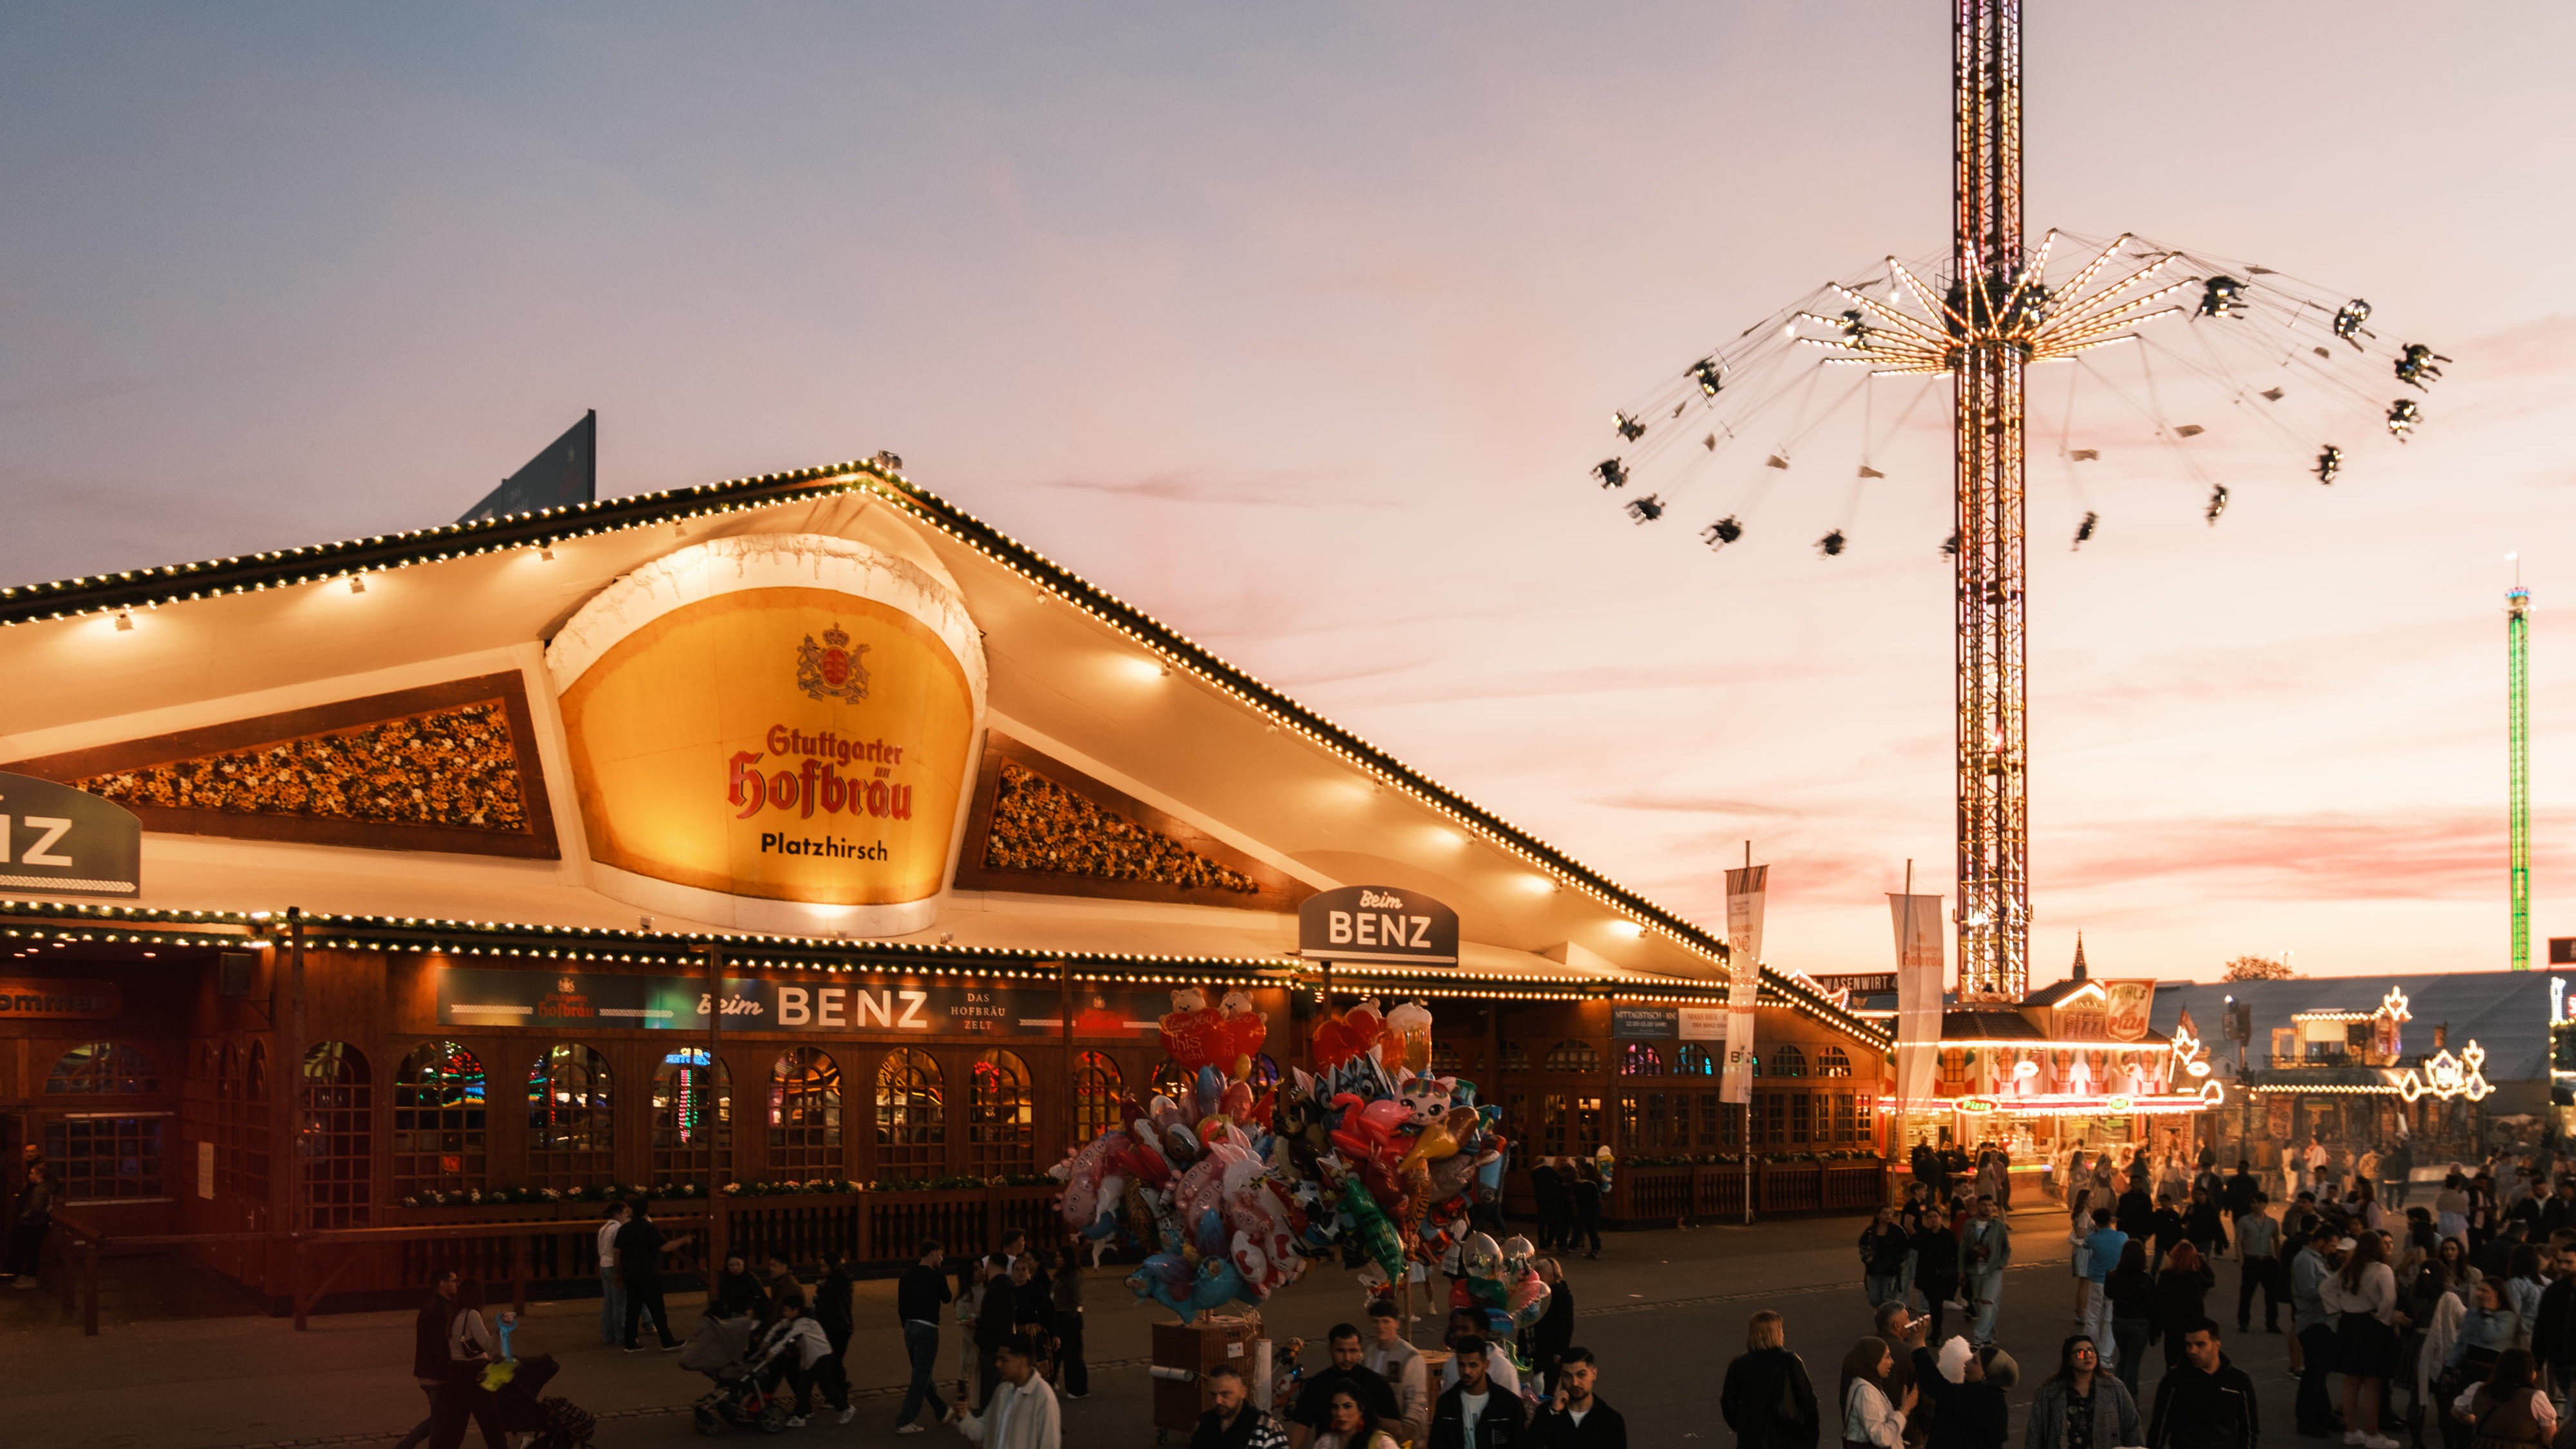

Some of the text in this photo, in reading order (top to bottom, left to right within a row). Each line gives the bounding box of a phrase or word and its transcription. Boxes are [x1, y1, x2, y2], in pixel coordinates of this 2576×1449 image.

[766, 724, 904, 767] Stuttgarter
[727, 750, 913, 821] Hofbräu
[0, 814, 72, 866] Z
[761, 832, 887, 861] Platzhirsch
[1359, 890, 1403, 909] Beim
[1329, 911, 1432, 948] BENZ
[1824, 976, 1888, 990] WASENWIRT
[778, 987, 927, 1028] BENZ
[967, 993, 989, 1003] DAS
[951, 1006, 1006, 1017] HOFBRÄU
[964, 1020, 992, 1030] ZELT
[2108, 1016, 2145, 1030] PIZZA
[1170, 1029, 1201, 1051] This
[1963, 1101, 1991, 1110] Pizza
